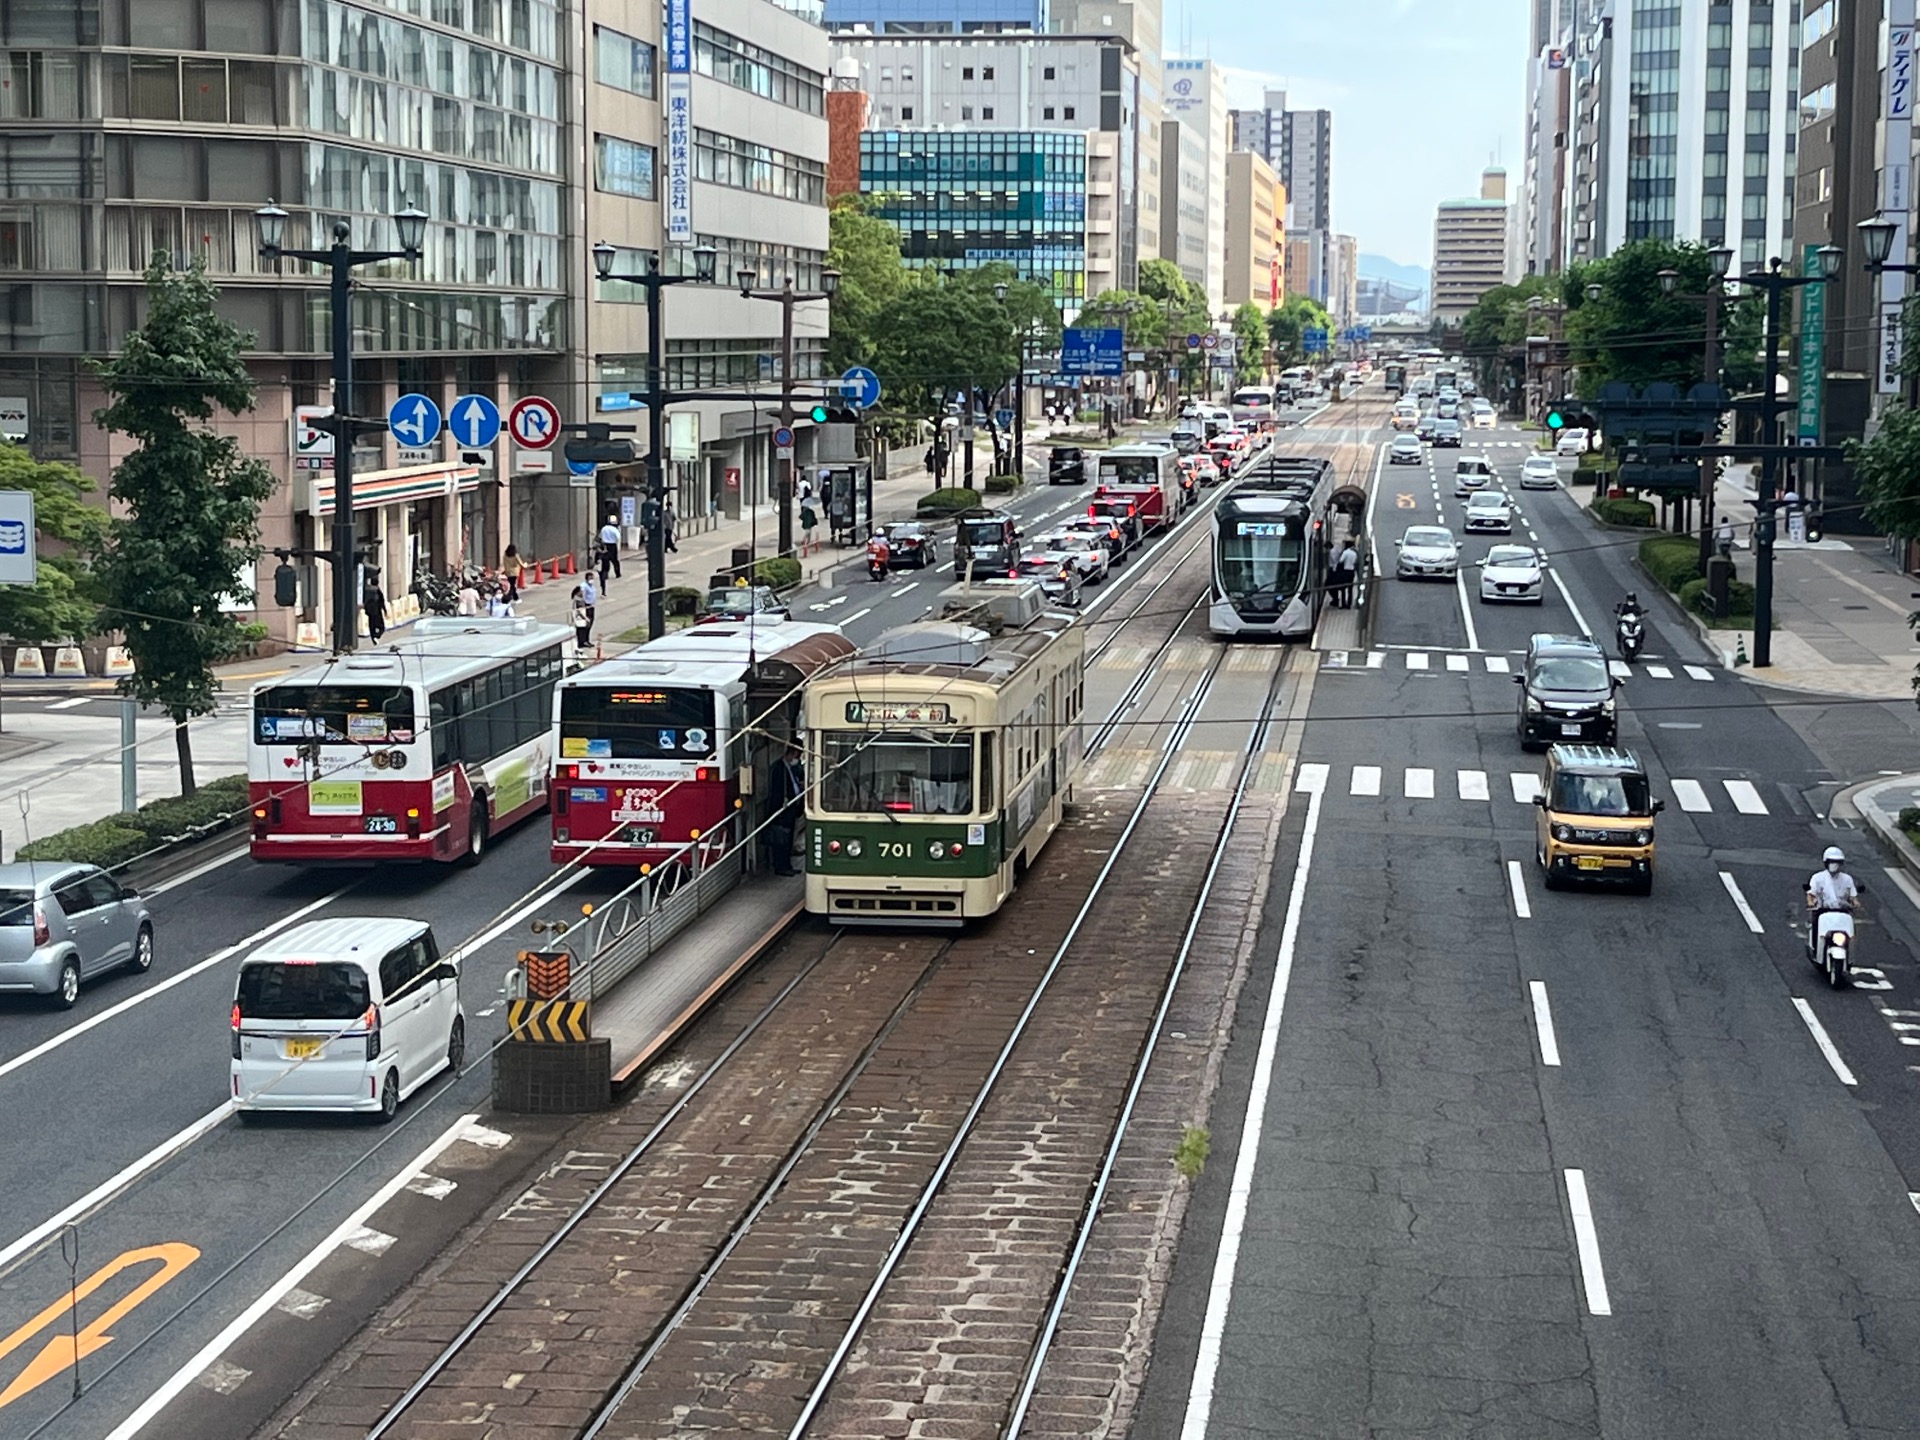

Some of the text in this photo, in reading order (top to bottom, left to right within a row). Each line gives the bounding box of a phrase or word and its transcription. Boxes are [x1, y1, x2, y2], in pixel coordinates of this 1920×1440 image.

[1890, 50, 1910, 114] ティグレ
[671, 97, 687, 210] 東洋紡株式会社
[877, 842, 912, 858] 701
